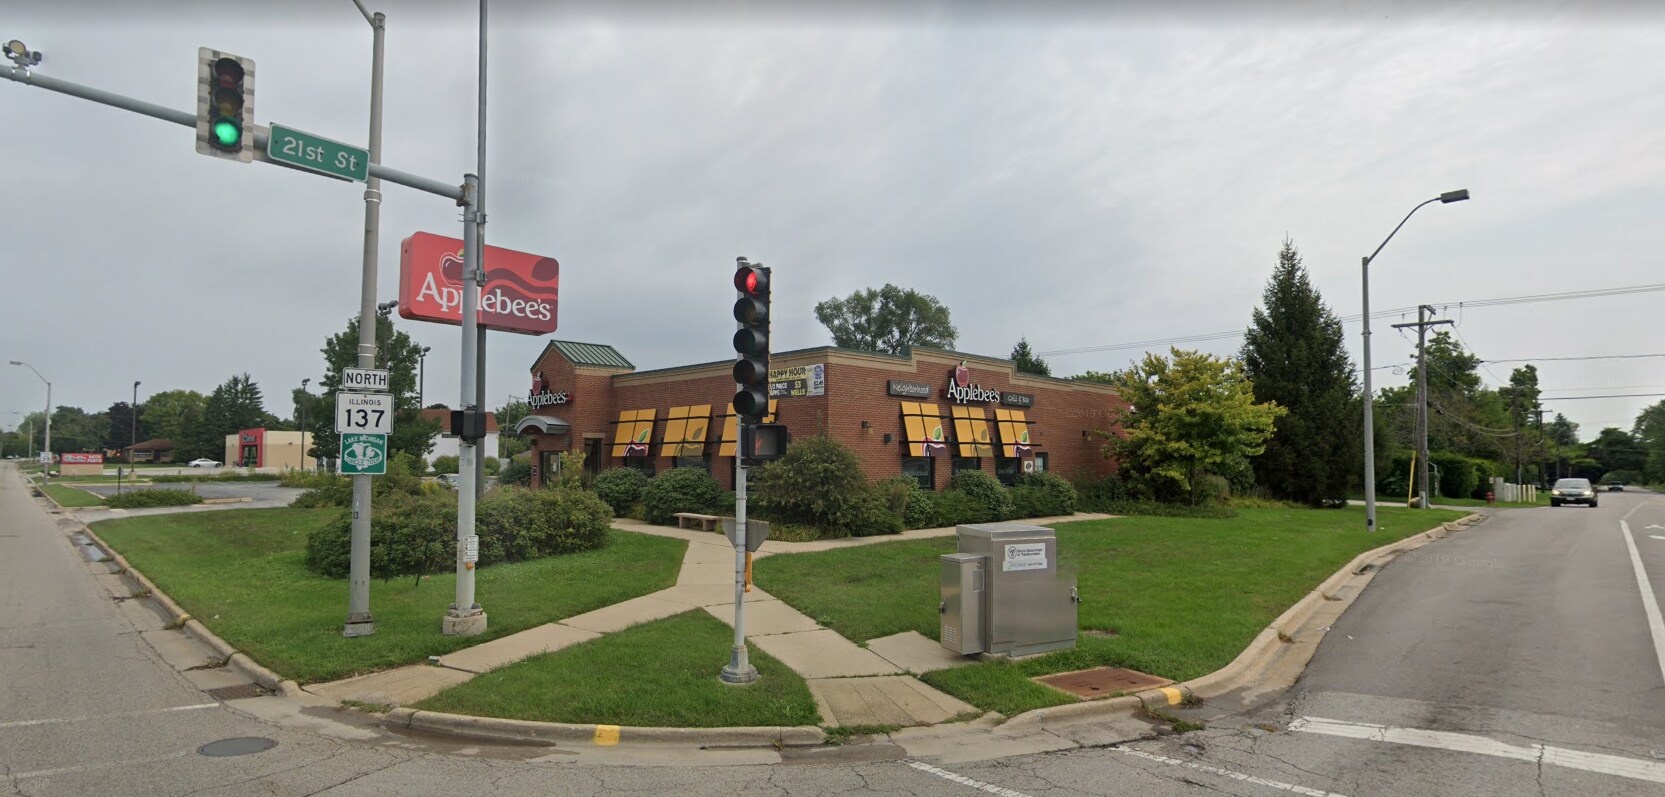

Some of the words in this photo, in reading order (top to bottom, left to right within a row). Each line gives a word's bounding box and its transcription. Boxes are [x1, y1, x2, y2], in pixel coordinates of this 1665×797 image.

[283, 136, 324, 163] 21st
[335, 151, 357, 171] St
[416, 271, 552, 321] Aplebee's
[789, 366, 806, 376] HOUR
[346, 372, 387, 386] NORTH
[794, 380, 802, 389] $3
[776, 382, 788, 390] PRICE
[947, 377, 1000, 403] Applebee's
[528, 388, 566, 409] Applebee's
[790, 388, 806, 397] WELLS
[349, 398, 381, 406] ILLINOIS
[346, 408, 385, 428] 137
[344, 436, 358, 445] LAKE
[360, 434, 384, 445] MICHIGAN
